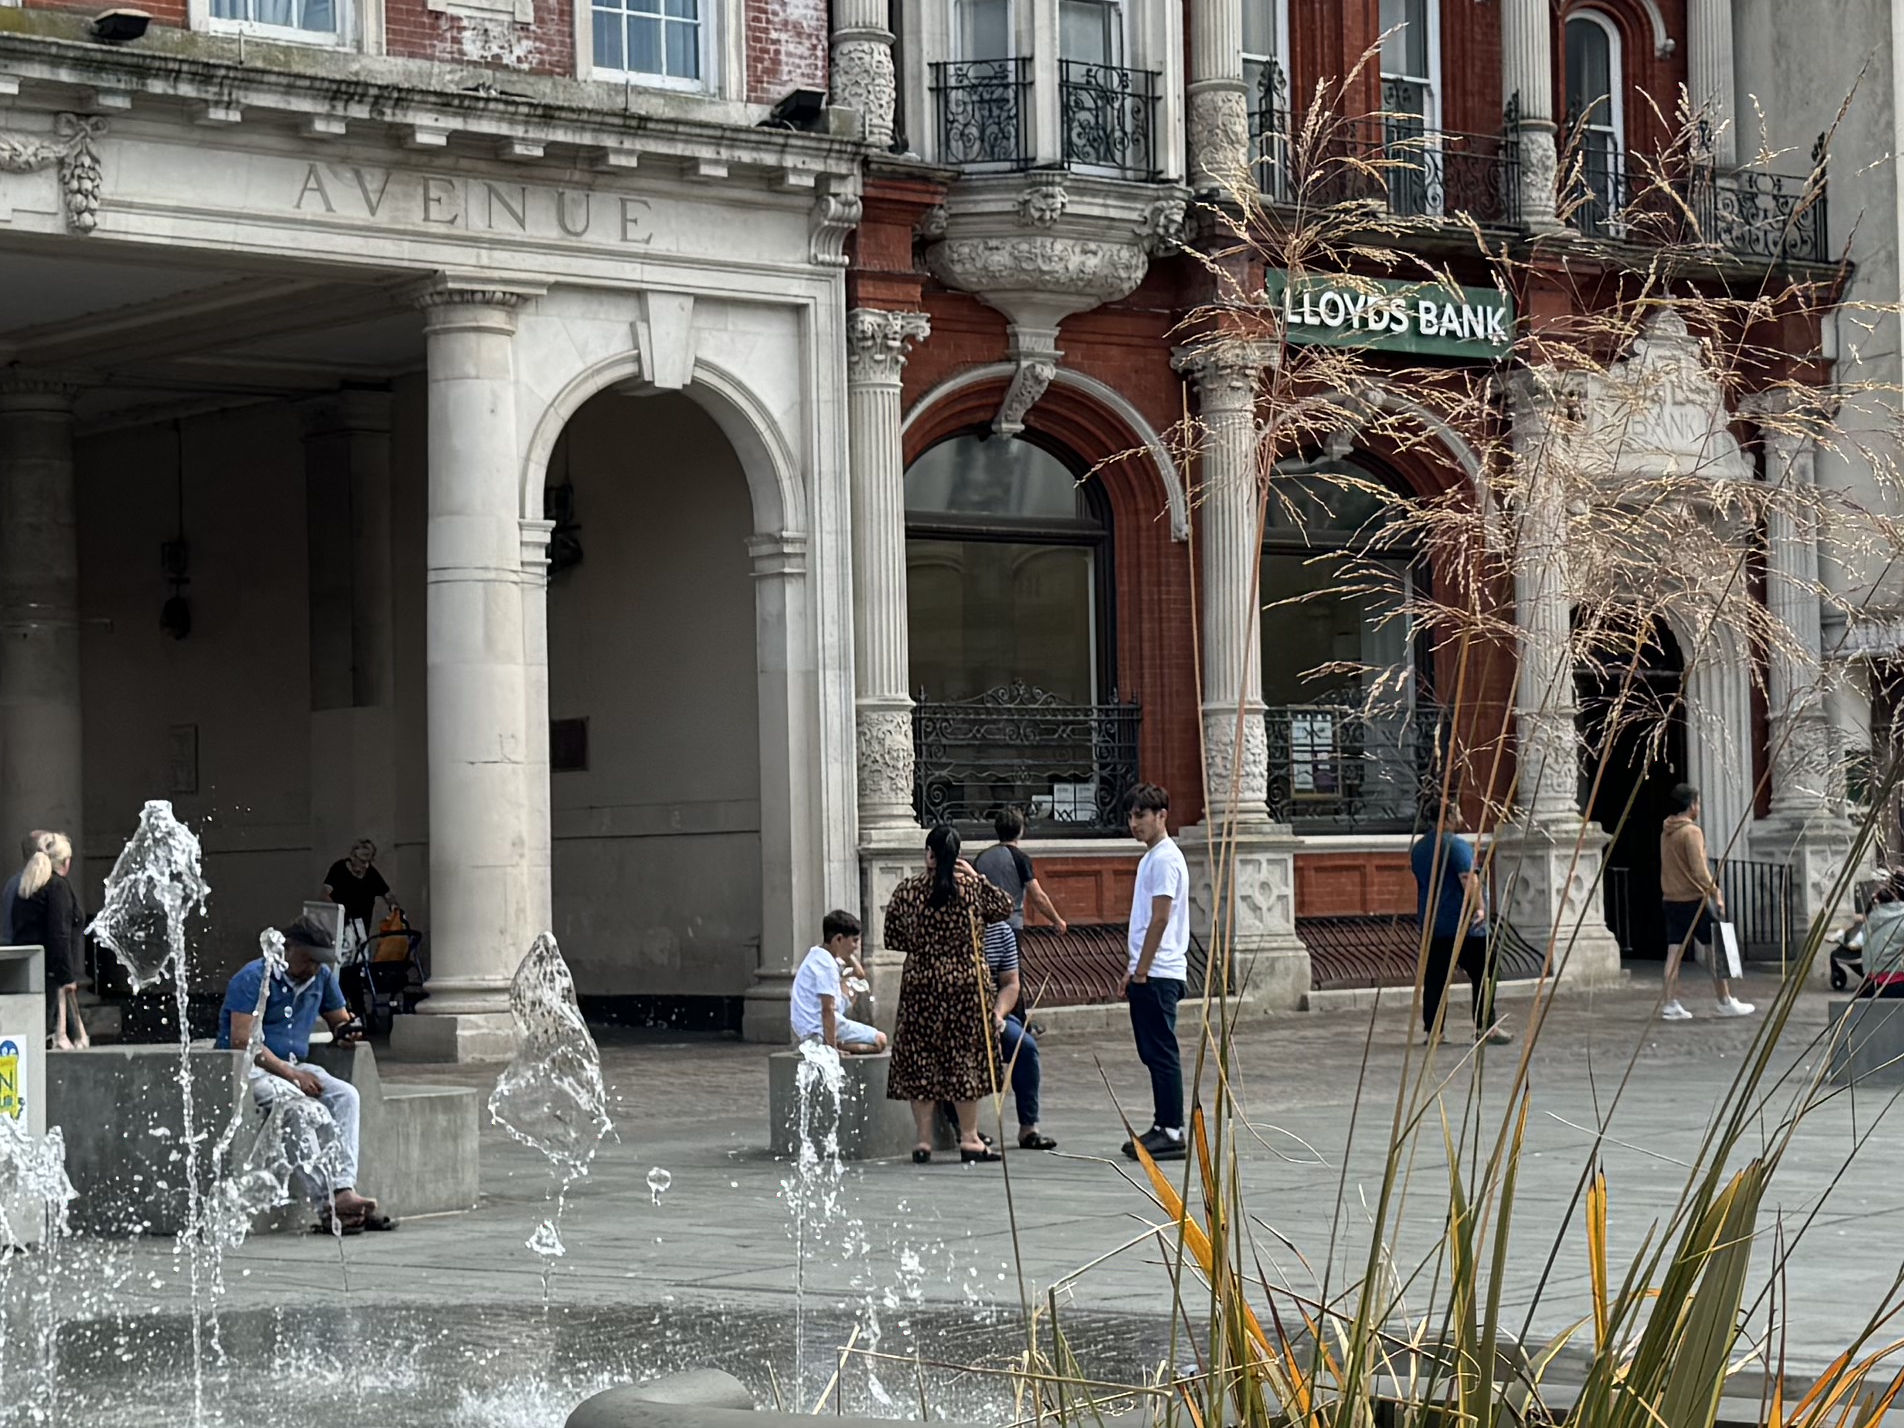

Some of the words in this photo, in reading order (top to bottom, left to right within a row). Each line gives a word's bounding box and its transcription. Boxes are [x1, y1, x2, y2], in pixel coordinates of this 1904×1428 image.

[293, 163, 653, 245] AVENUE
[1286, 289, 1409, 333] LLOYDS
[1419, 300, 1509, 343] BANK
